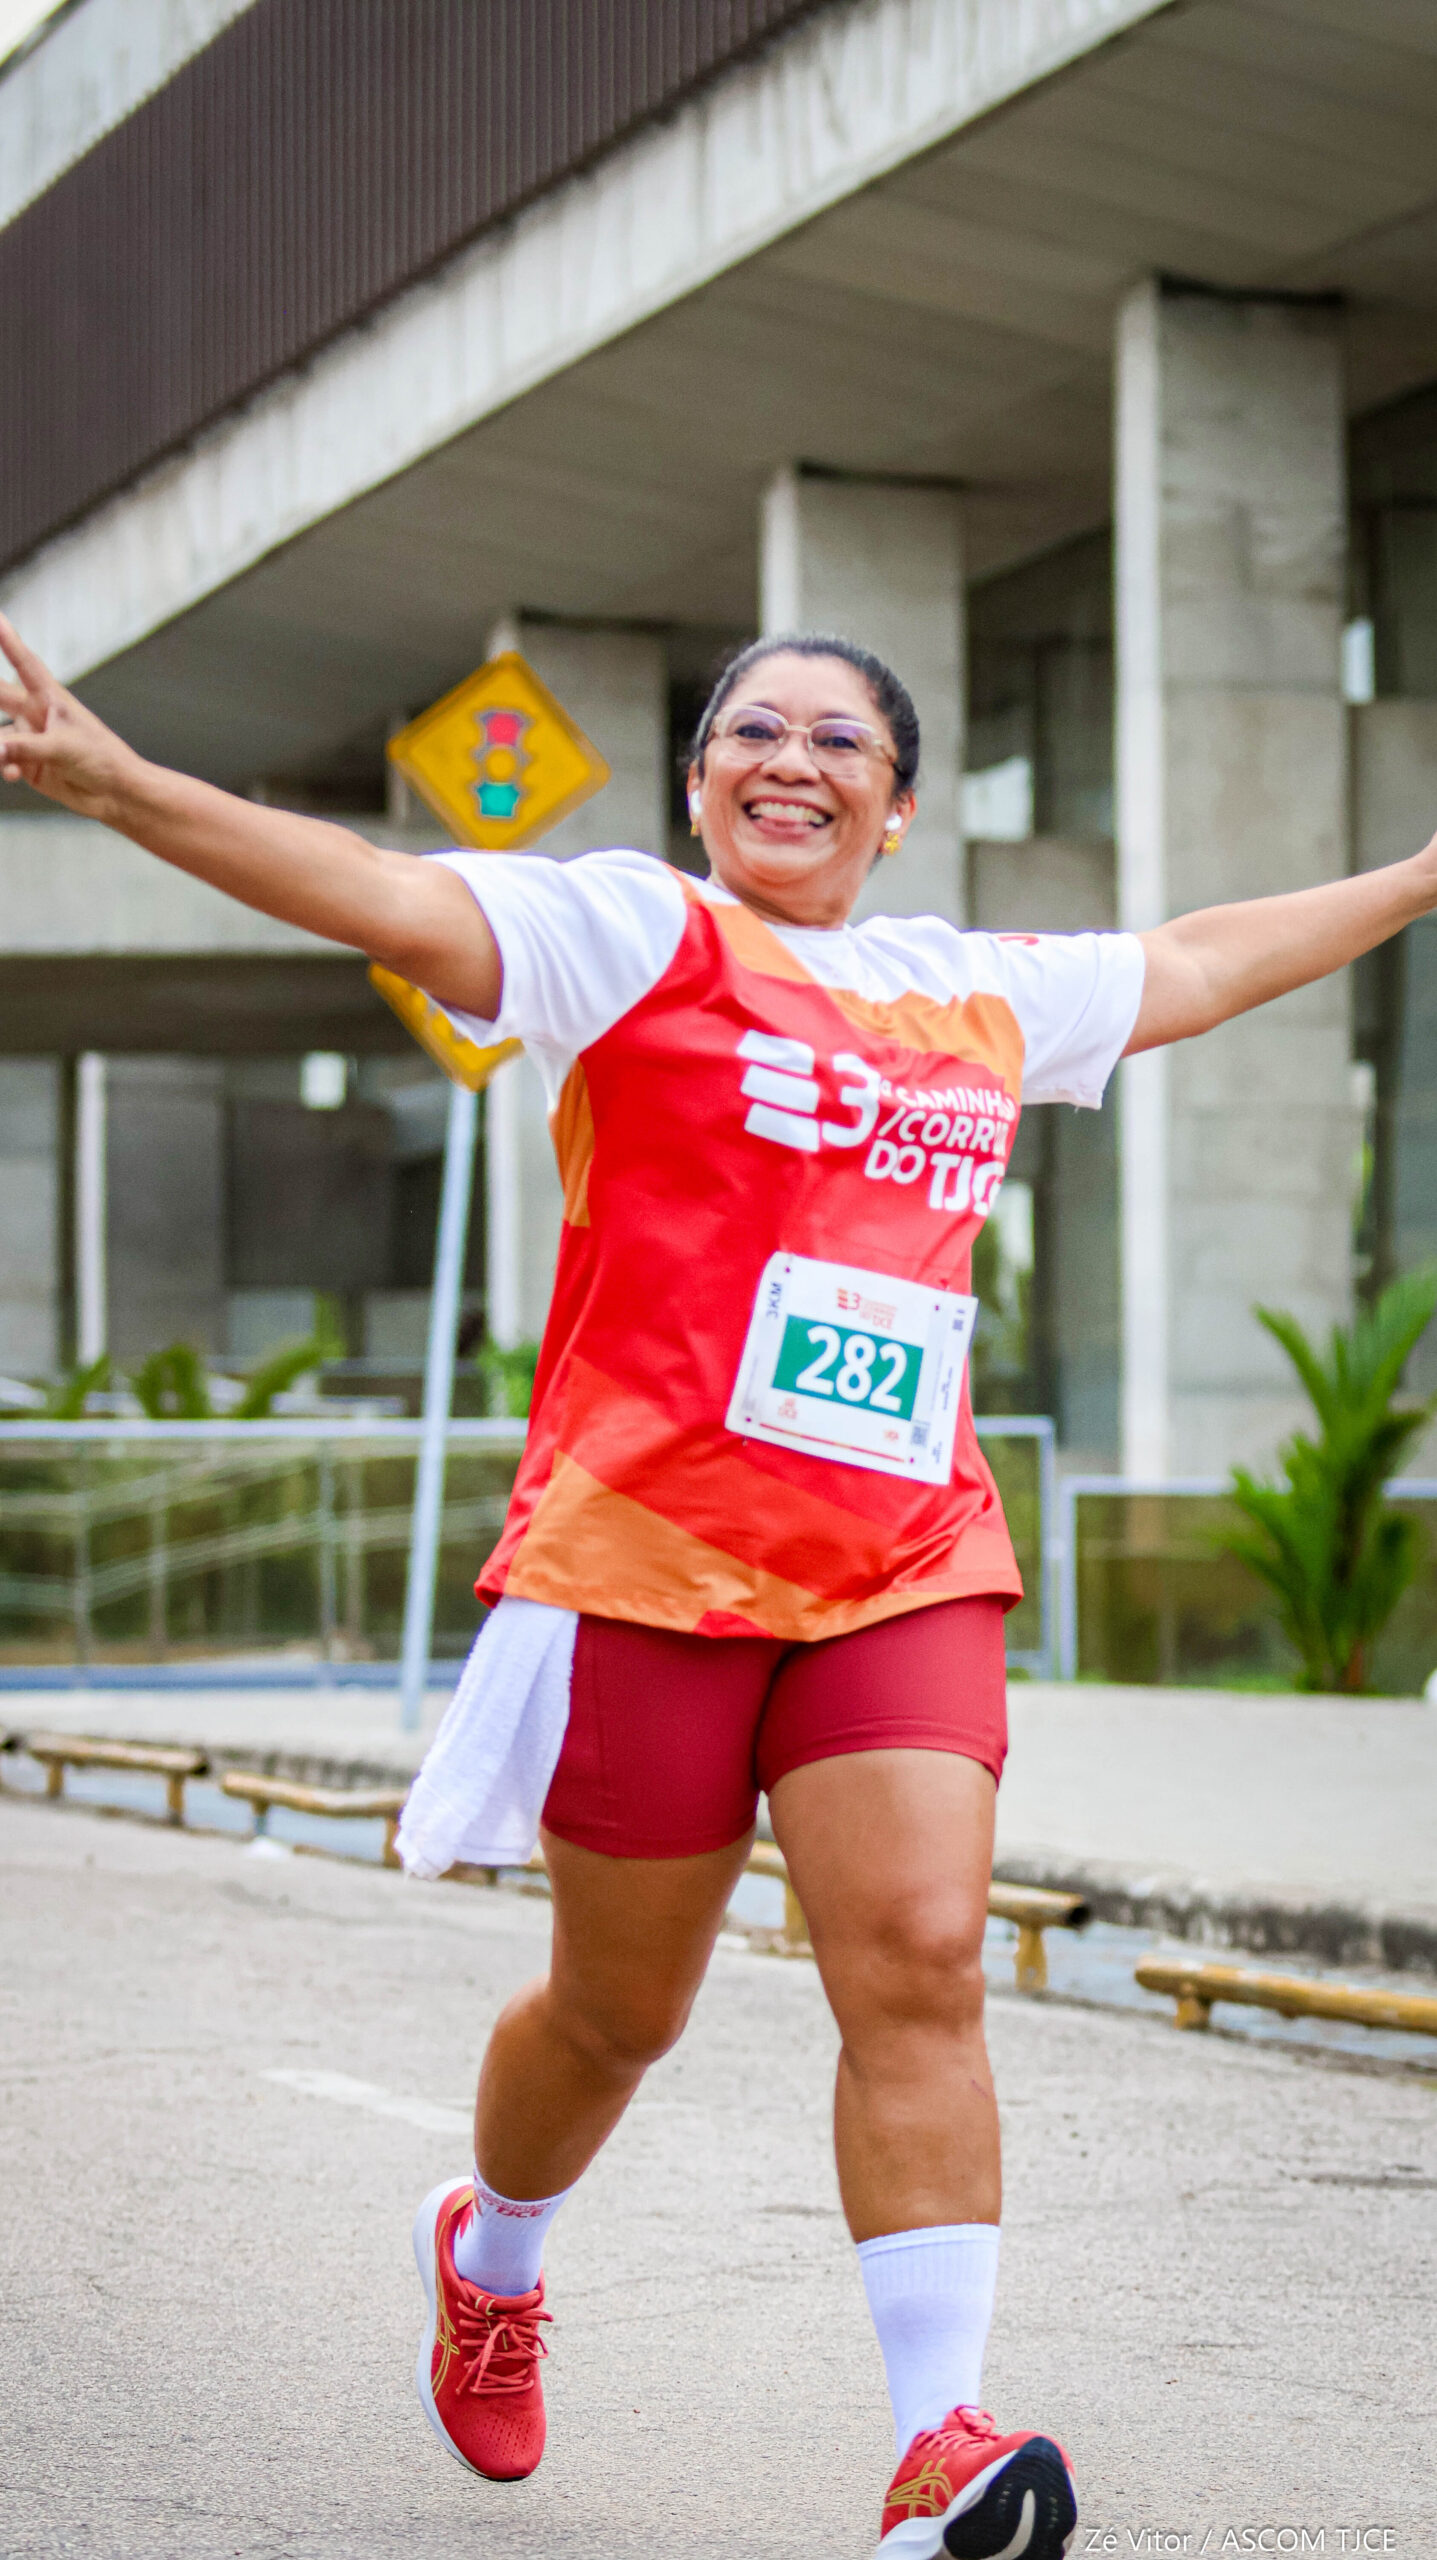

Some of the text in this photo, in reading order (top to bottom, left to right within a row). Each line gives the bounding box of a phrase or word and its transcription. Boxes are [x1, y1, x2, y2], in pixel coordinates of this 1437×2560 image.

[864, 1139, 1005, 1217] DO TJC
[795, 1325, 908, 1413] 282
